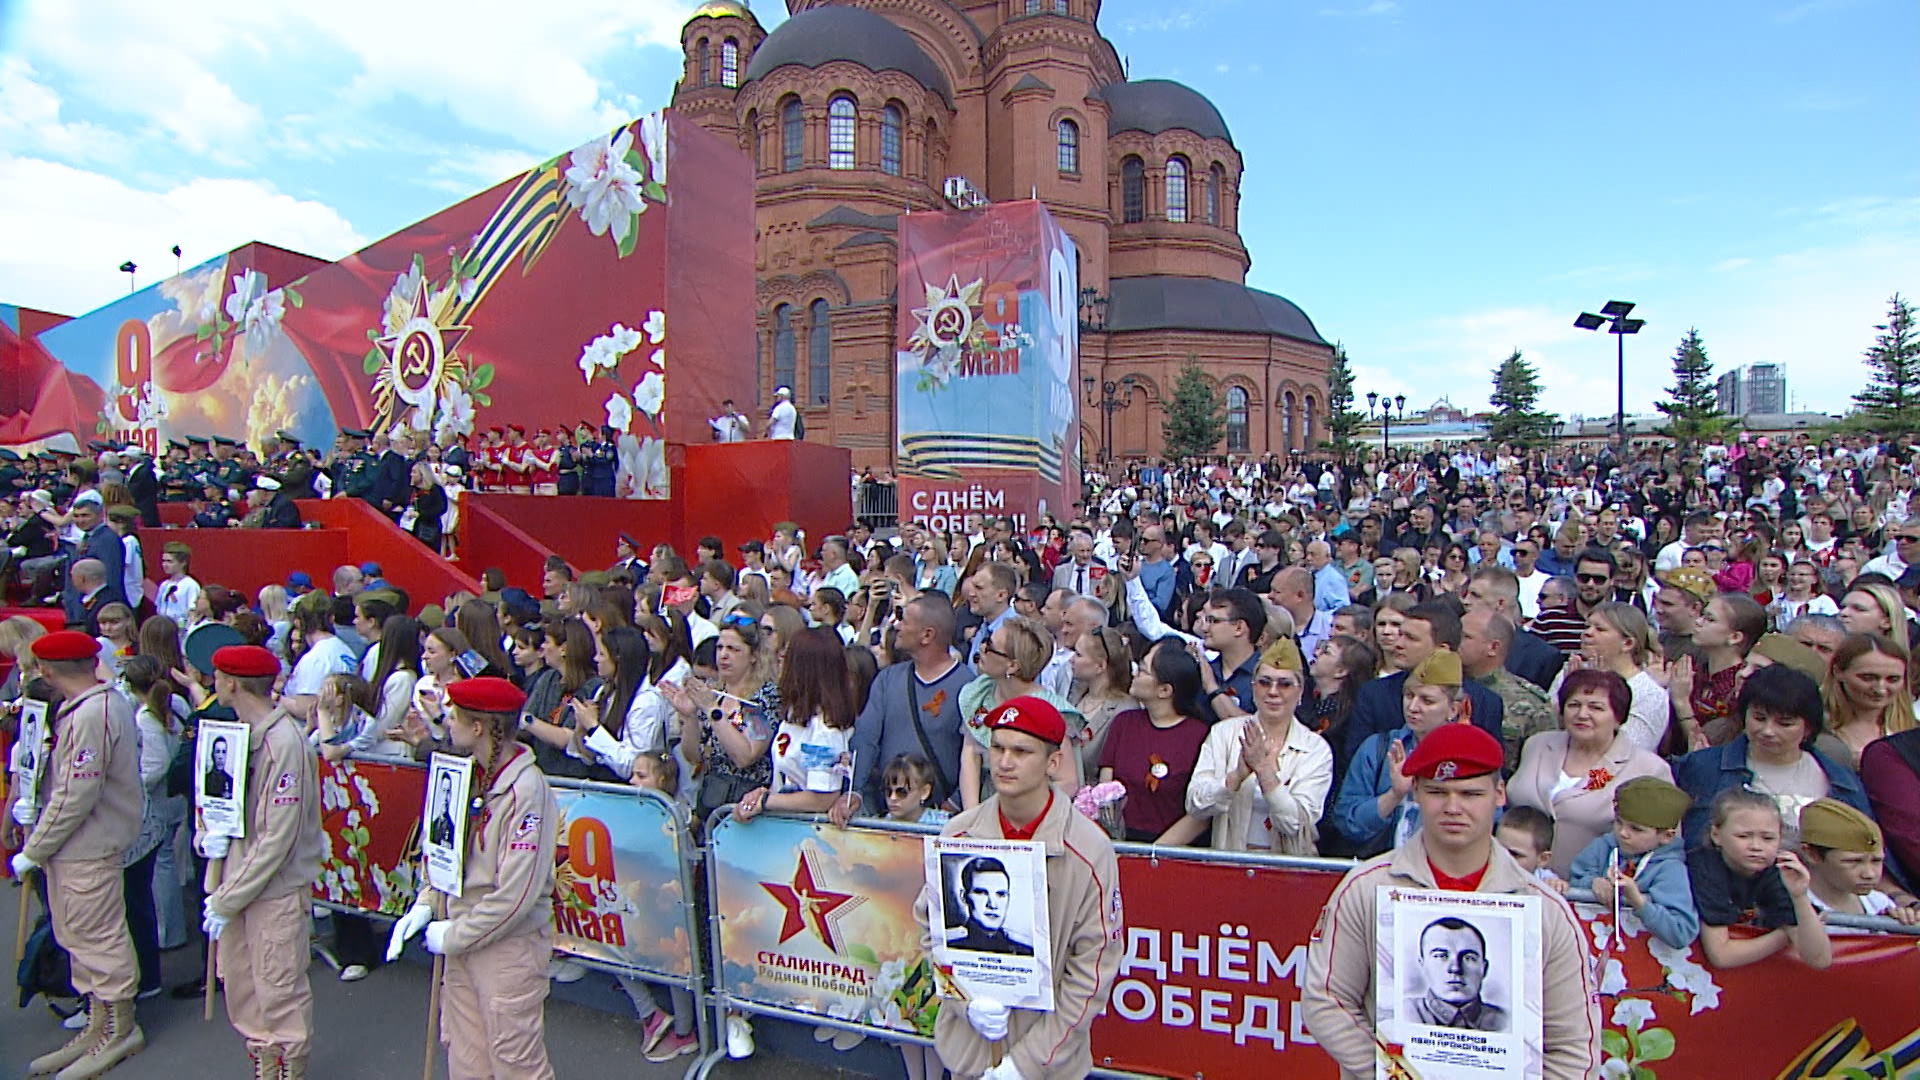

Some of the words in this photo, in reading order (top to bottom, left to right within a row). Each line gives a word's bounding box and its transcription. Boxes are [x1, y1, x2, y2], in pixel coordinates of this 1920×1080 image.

[983, 281, 1018, 348] 9
[117, 319, 151, 422] 9
[911, 491, 928, 511] С
[932, 485, 1005, 514] ДНЁМ
[568, 816, 616, 908] 9
[757, 951, 866, 985] СТАЛИНГРАД
[758, 965, 808, 986] Родина
[812, 975, 873, 997] Победы!
[1119, 923, 1308, 988] ДНЁМ
[1100, 978, 1321, 1052] ОБЕД
